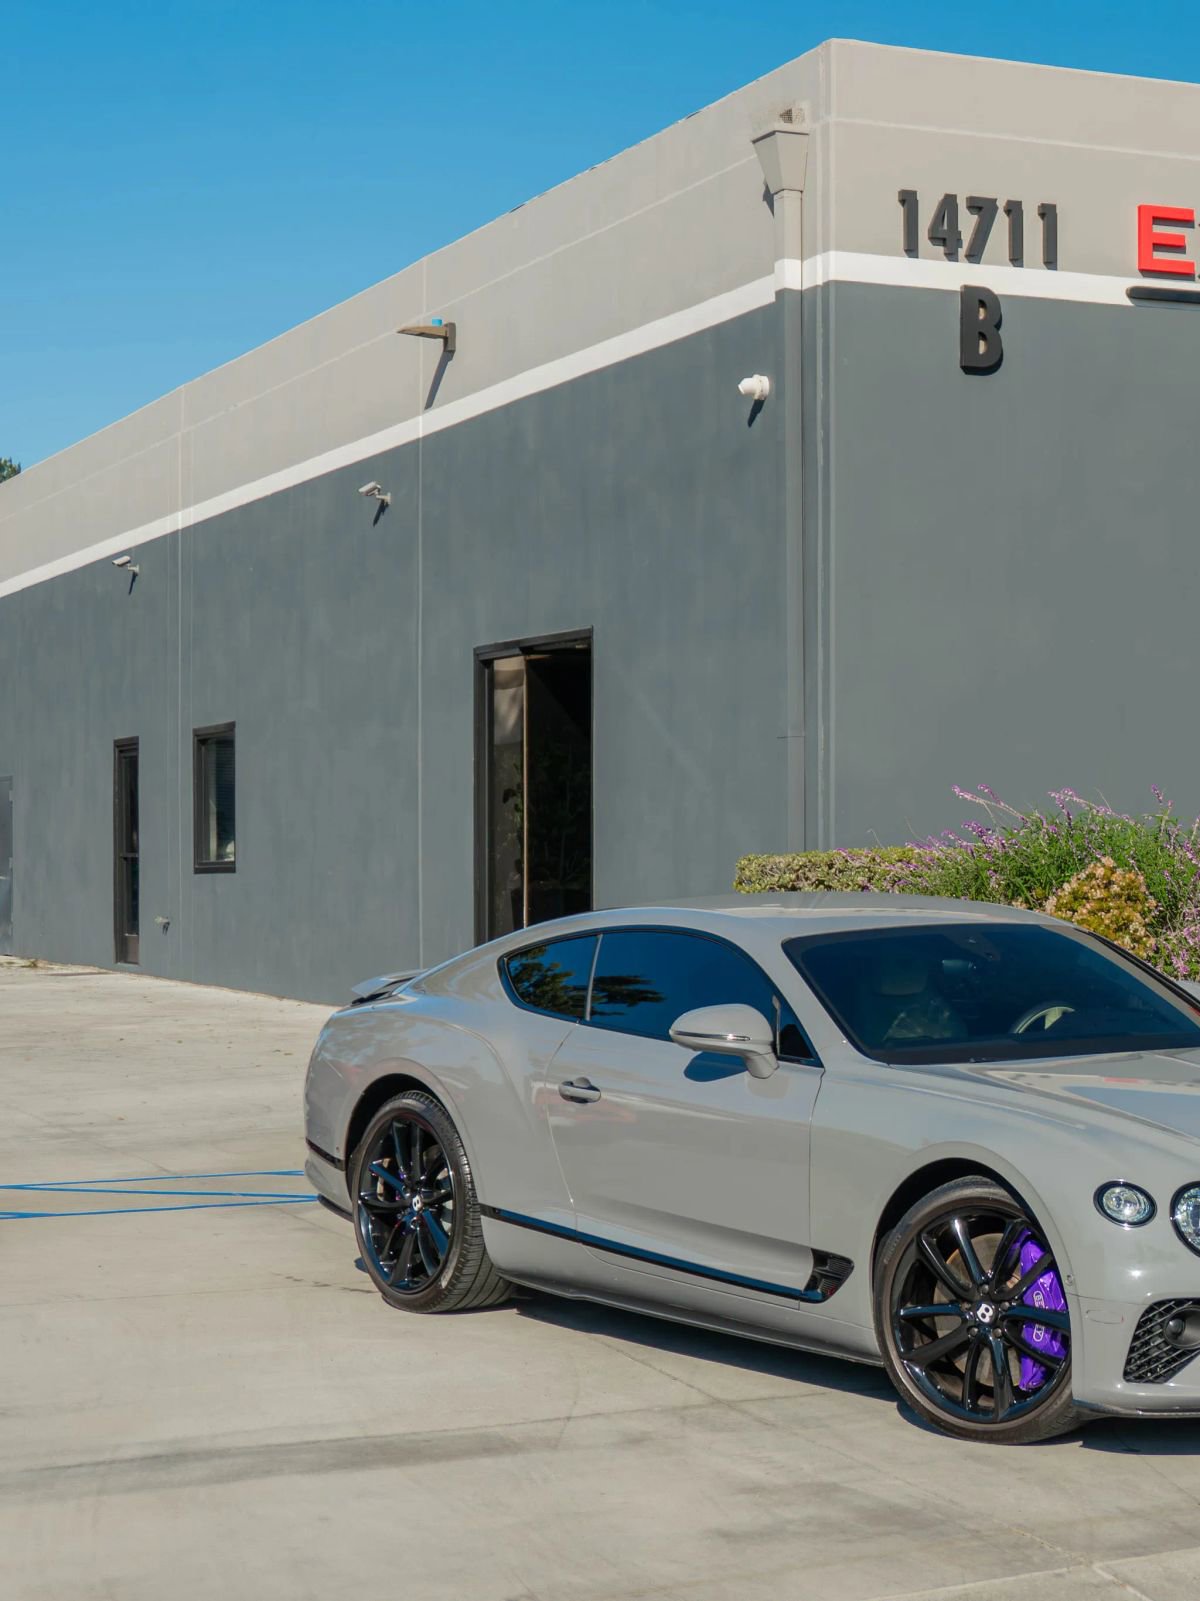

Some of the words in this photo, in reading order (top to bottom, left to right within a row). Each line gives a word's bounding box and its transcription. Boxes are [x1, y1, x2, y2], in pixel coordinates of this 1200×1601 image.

[898, 189, 1058, 269] 14711
[960, 285, 1003, 375] B
[976, 1303, 993, 1323] B
